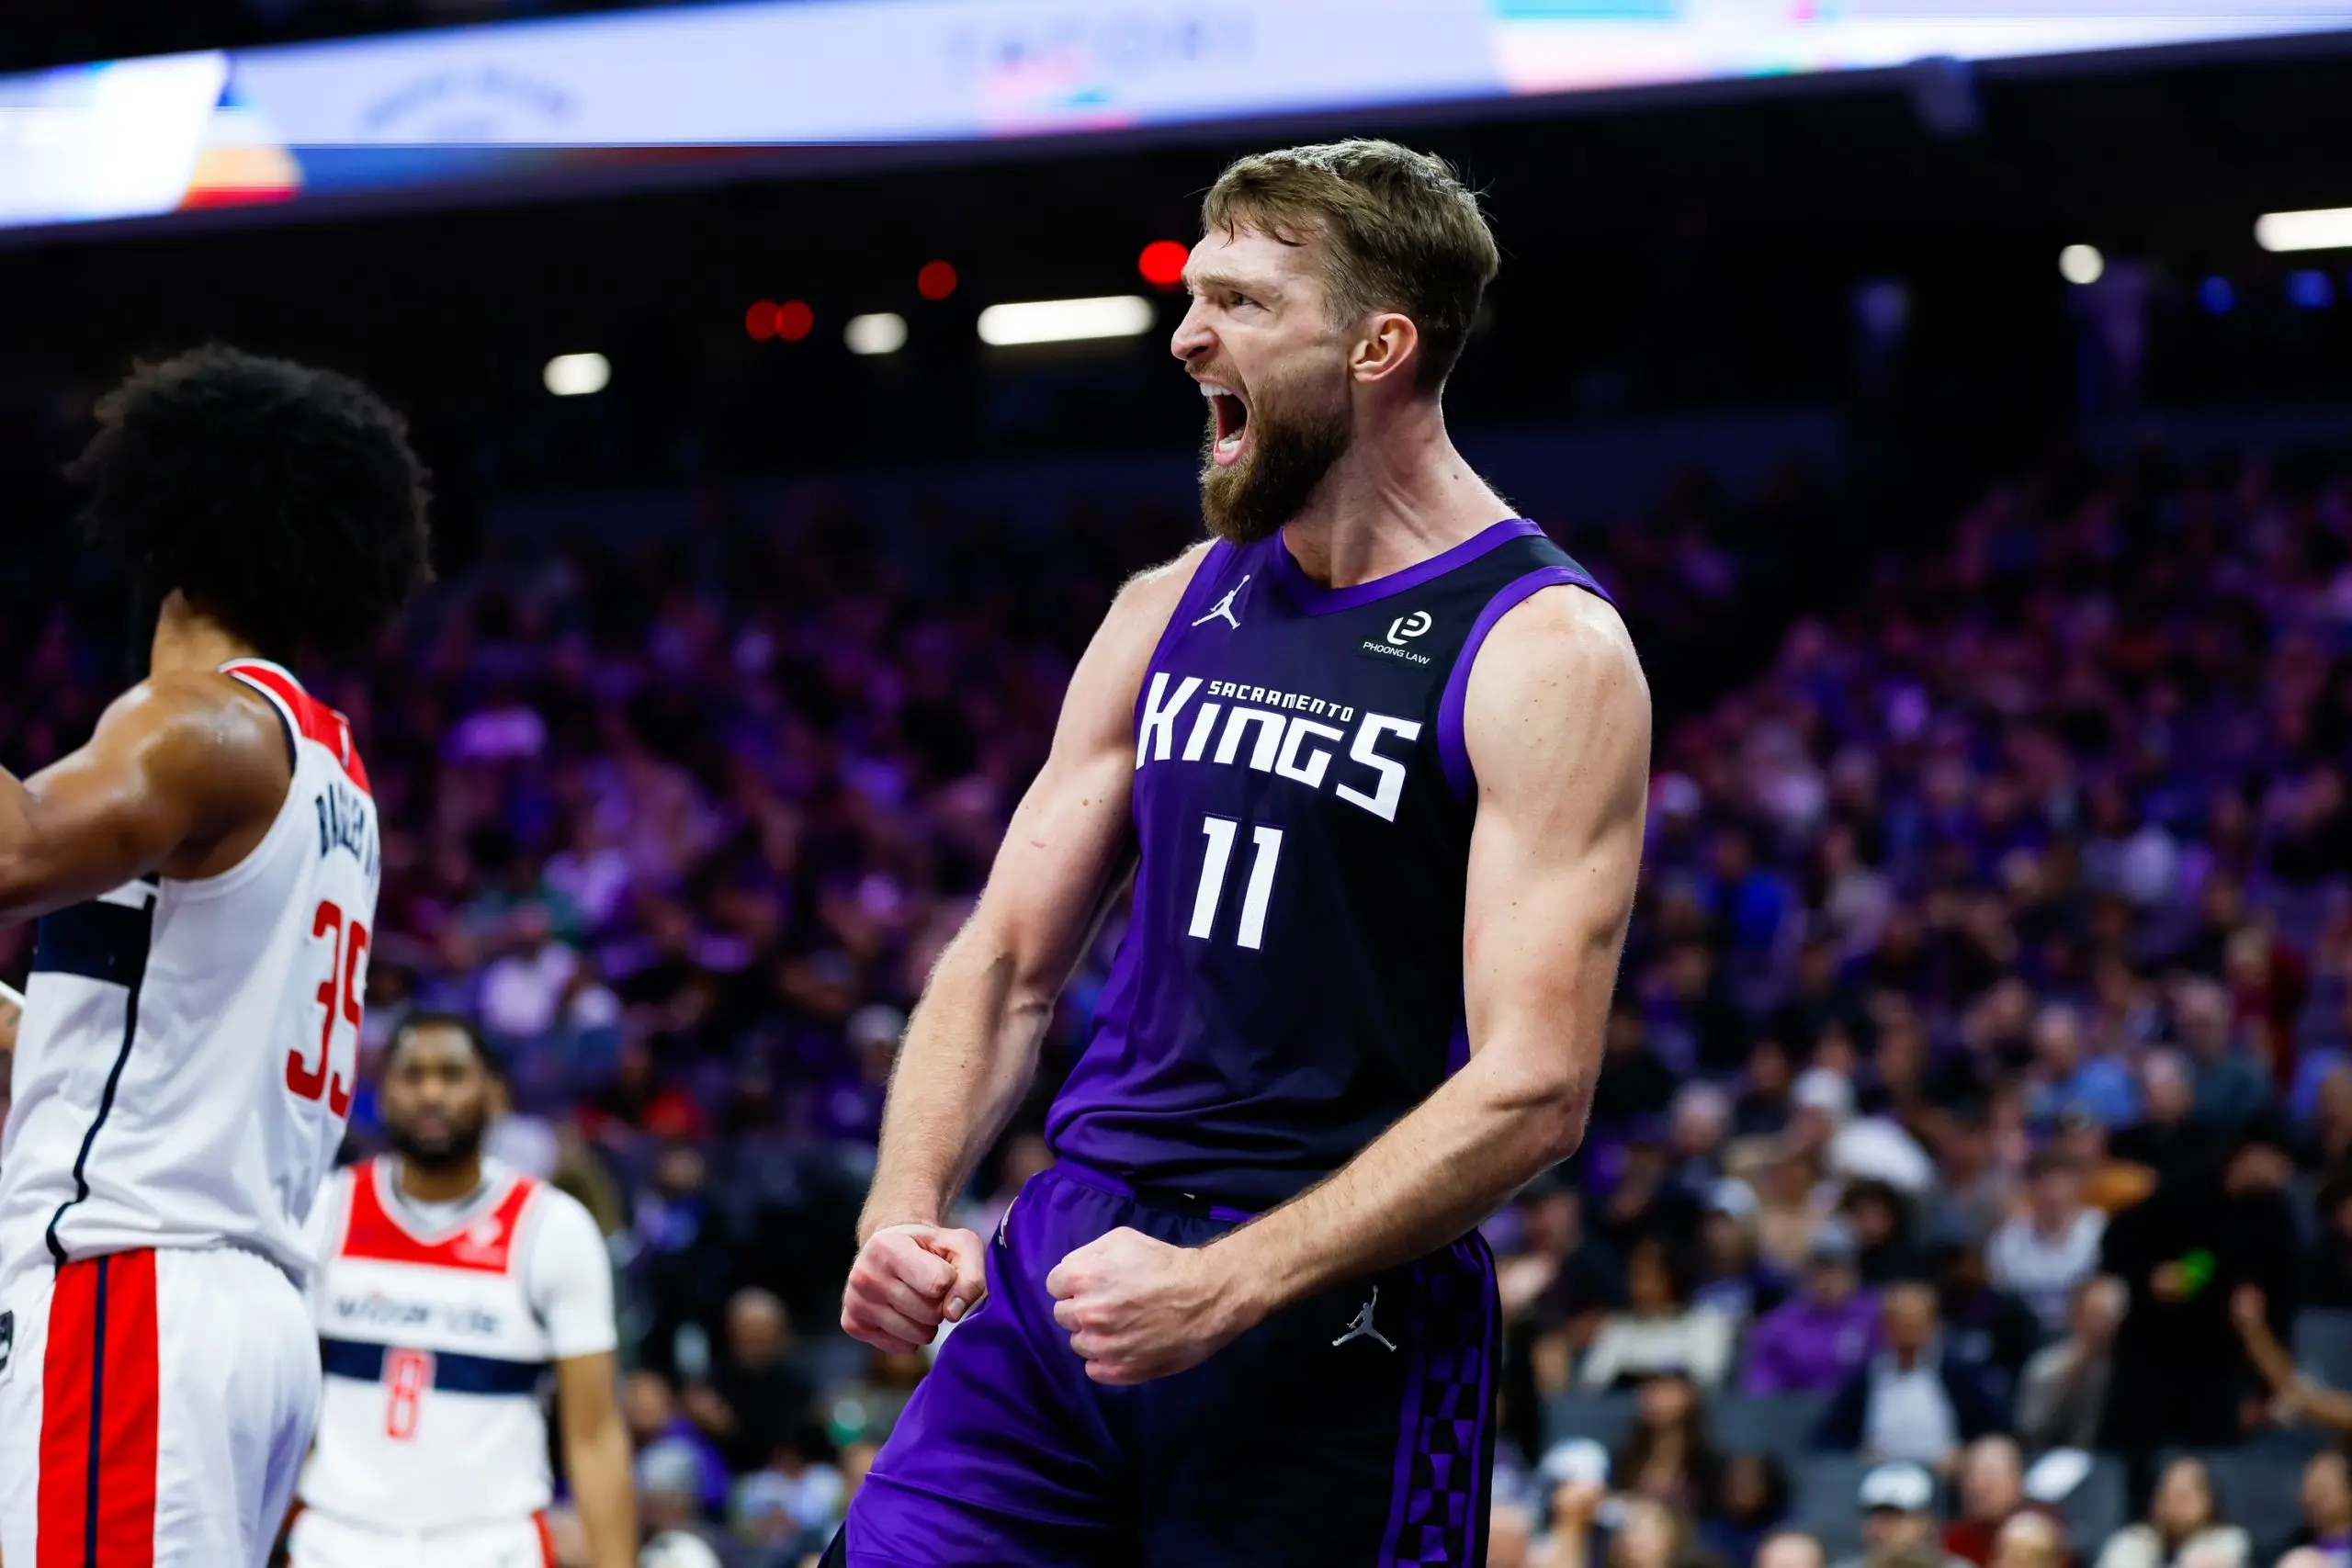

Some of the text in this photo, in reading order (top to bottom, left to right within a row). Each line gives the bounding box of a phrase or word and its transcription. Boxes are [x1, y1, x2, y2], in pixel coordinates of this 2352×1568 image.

[1363, 641, 1430, 665] PHOONG LAW
[1136, 671, 1423, 823] KINGS
[1207, 680, 1355, 723] SACRAMENTO
[1188, 816, 1283, 950] 11
[384, 1347, 431, 1443] 8
